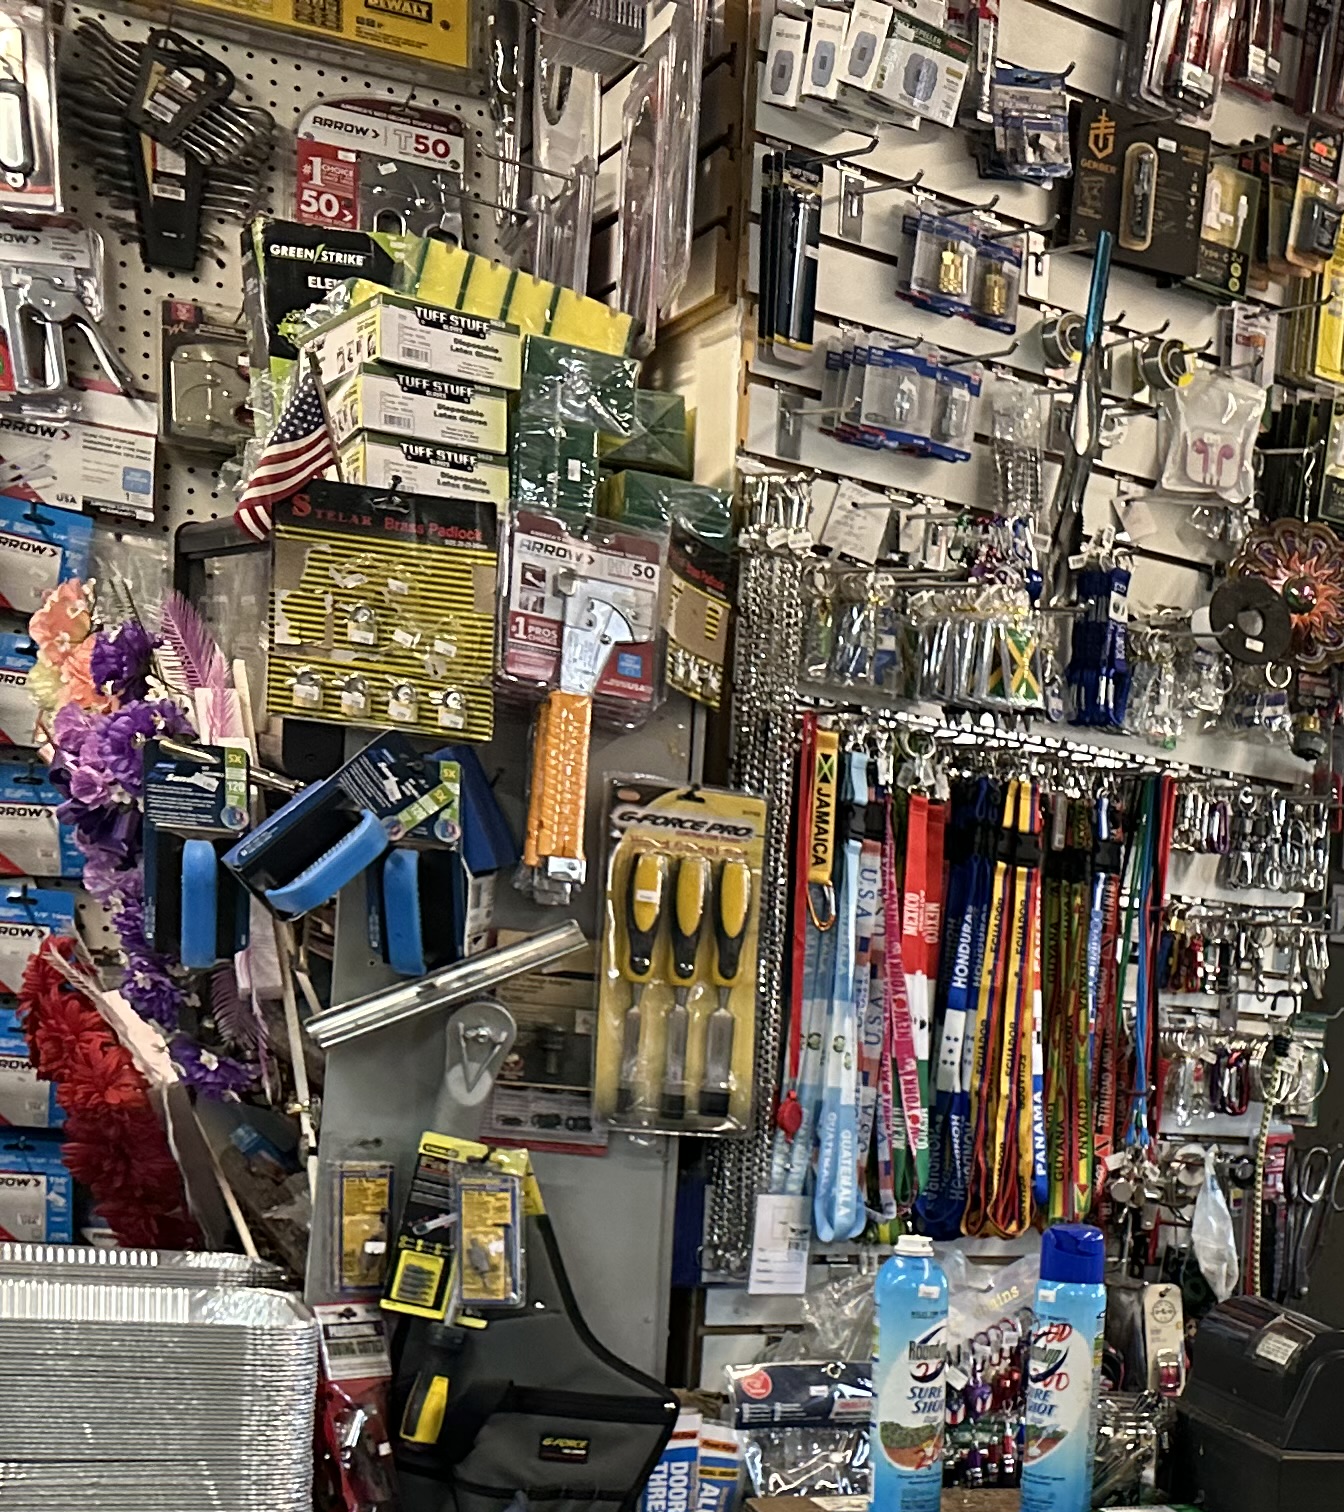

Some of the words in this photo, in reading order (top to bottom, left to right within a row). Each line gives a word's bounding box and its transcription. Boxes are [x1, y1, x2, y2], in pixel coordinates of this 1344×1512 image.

[312, 116, 369, 137] ARROW
[393, 130, 451, 159] T50
[1081, 158, 1117, 175] GERBER
[300, 190, 340, 217] 50
[270, 244, 315, 260] GREEN
[321, 250, 365, 267] STRIKE
[415, 306, 447, 324] TUFF
[450, 313, 490, 333] STUFF
[397, 374, 429, 393] TUFF
[433, 381, 475, 399] STUFF
[401, 443, 432, 461] TUFF
[436, 450, 478, 467] STUFF
[384, 516, 424, 536] Brass
[428, 521, 483, 542] Padlock
[519, 538, 584, 562] ARROW
[618, 810, 699, 834] G-FORCE
[704, 818, 755, 840] PRO
[812, 785, 828, 868] JAMAICA
[903, 891, 920, 937] MEXICO
[1033, 1090, 1048, 1176] PANAMA
